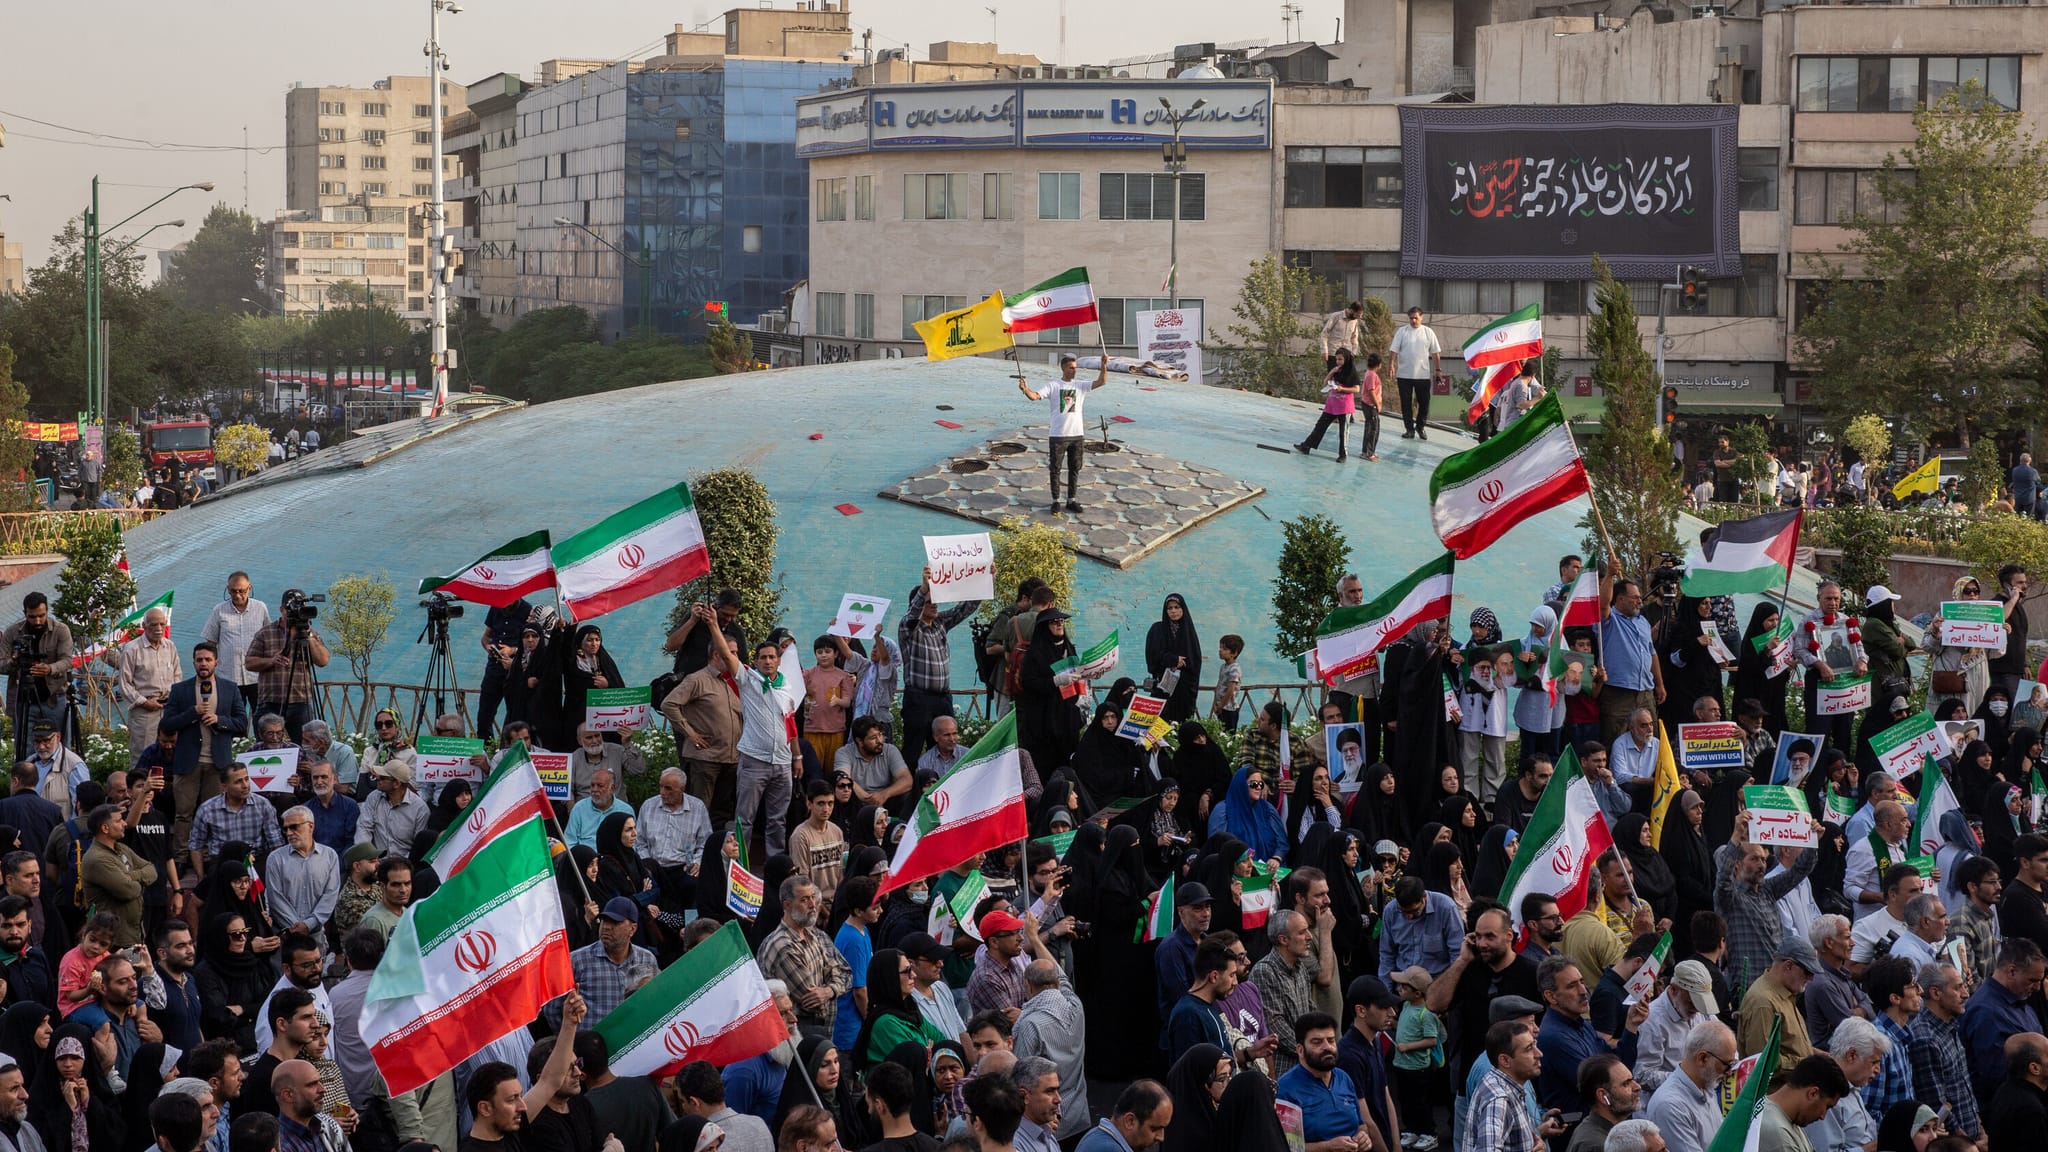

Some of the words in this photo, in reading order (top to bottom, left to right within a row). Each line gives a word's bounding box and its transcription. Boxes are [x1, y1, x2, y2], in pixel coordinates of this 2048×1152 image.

[1028, 109, 1048, 119] BANK
[1050, 109, 1084, 119] SADERAT
[1086, 109, 1104, 119] IRAN
[1232, 98, 1265, 127] بانک
[906, 109, 937, 129] ایران
[1466, 156, 1522, 218] حسین
[1568, 157, 1608, 217] عالم
[1597, 155, 1692, 216] آزادگان
[1665, 376, 1703, 391] پایتخت
[1704, 376, 1750, 389] فروشگاه
[931, 562, 954, 585] ایران
[1949, 623, 1989, 633] آخر
[1993, 623, 2000, 632] تا
[1951, 633, 1965, 644] ایم
[1968, 634, 1999, 646] ایستاده
[1824, 686, 1859, 702] آخر
[593, 706, 635, 719] آخر
[638, 705, 645, 713] تا
[1825, 702, 1840, 712] ایم
[594, 719, 610, 729] ایم
[612, 717, 644, 728] ایستاده
[1926, 731, 1936, 741] تا
[1721, 739, 1740, 749] مرگ
[1708, 753, 1727, 761] WITH
[1727, 752, 1741, 760] USA
[1888, 736, 1923, 767] آخر
[1910, 744, 1942, 766] ایتاده
[423, 757, 464, 768] آخر
[1896, 760, 1910, 777] ایم
[425, 769, 440, 780] ایم
[442, 769, 476, 779] ایستاده
[548, 771, 568, 781] مرگ
[1756, 812, 1800, 826] آخر
[1759, 826, 1774, 841] ایم
[1778, 828, 1811, 843] ایستاده
